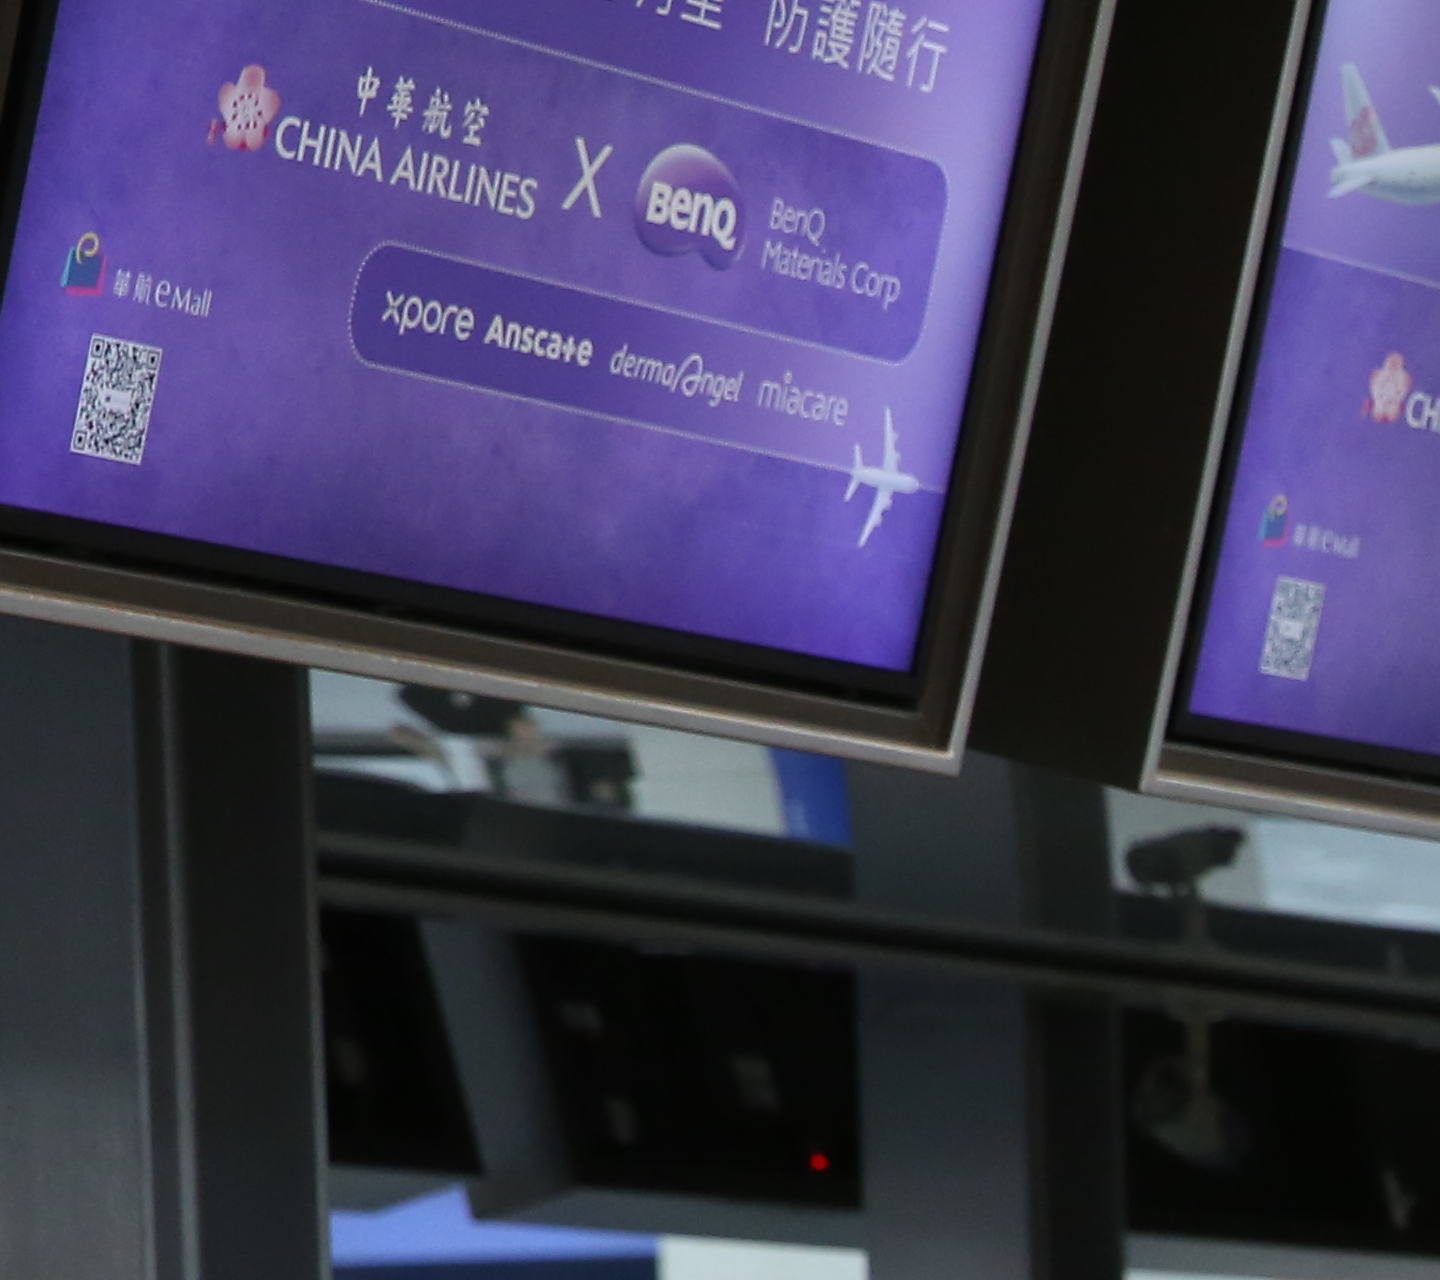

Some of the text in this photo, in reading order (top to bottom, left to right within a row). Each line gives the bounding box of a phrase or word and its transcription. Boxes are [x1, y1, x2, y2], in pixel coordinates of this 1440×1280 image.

[357, 65, 490, 147] 中華航空
[274, 116, 538, 220] CHINA AIRLINES
[769, 198, 827, 247] BenQ
[759, 240, 902, 311] Materials Corp
[381, 289, 476, 341] xpore
[756, 369, 849, 426] miacare
